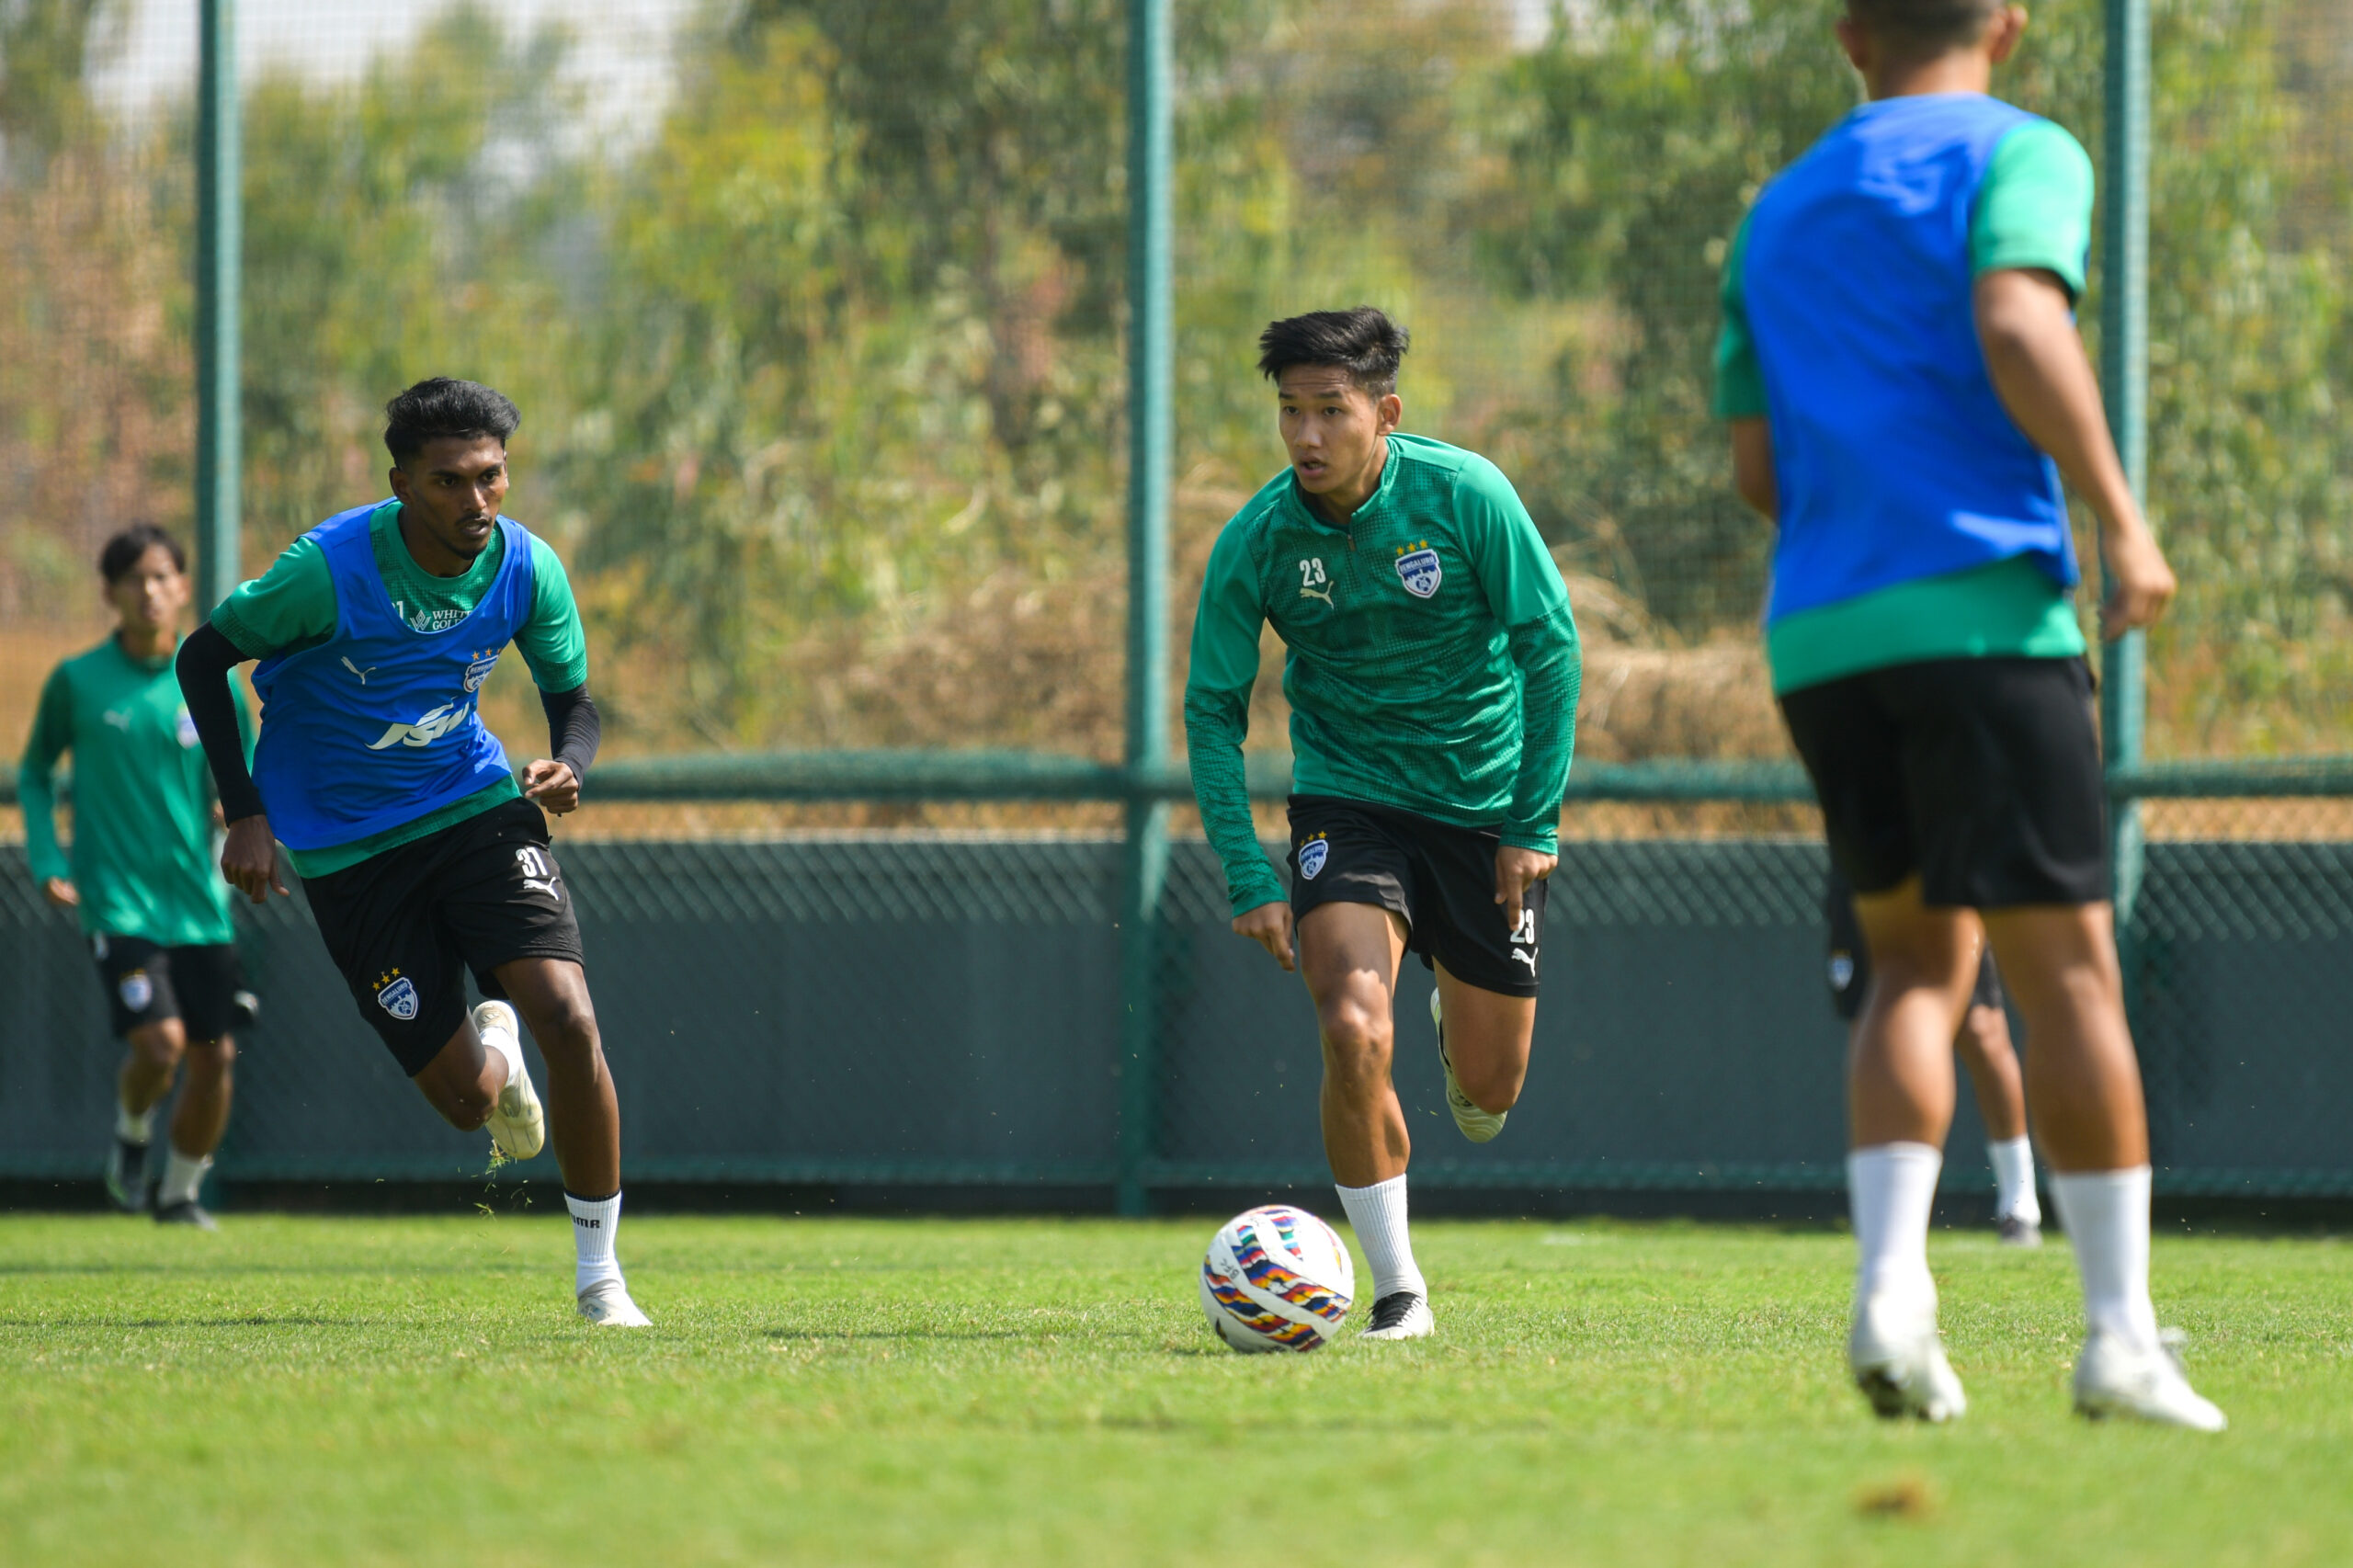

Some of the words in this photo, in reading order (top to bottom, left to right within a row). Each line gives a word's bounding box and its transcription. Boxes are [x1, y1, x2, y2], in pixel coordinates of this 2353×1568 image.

[1299, 557, 1326, 586] 23
[392, 600, 404, 620] 1
[363, 696, 470, 750] JSW
[515, 846, 548, 878] 31
[1509, 908, 1535, 945] 23
